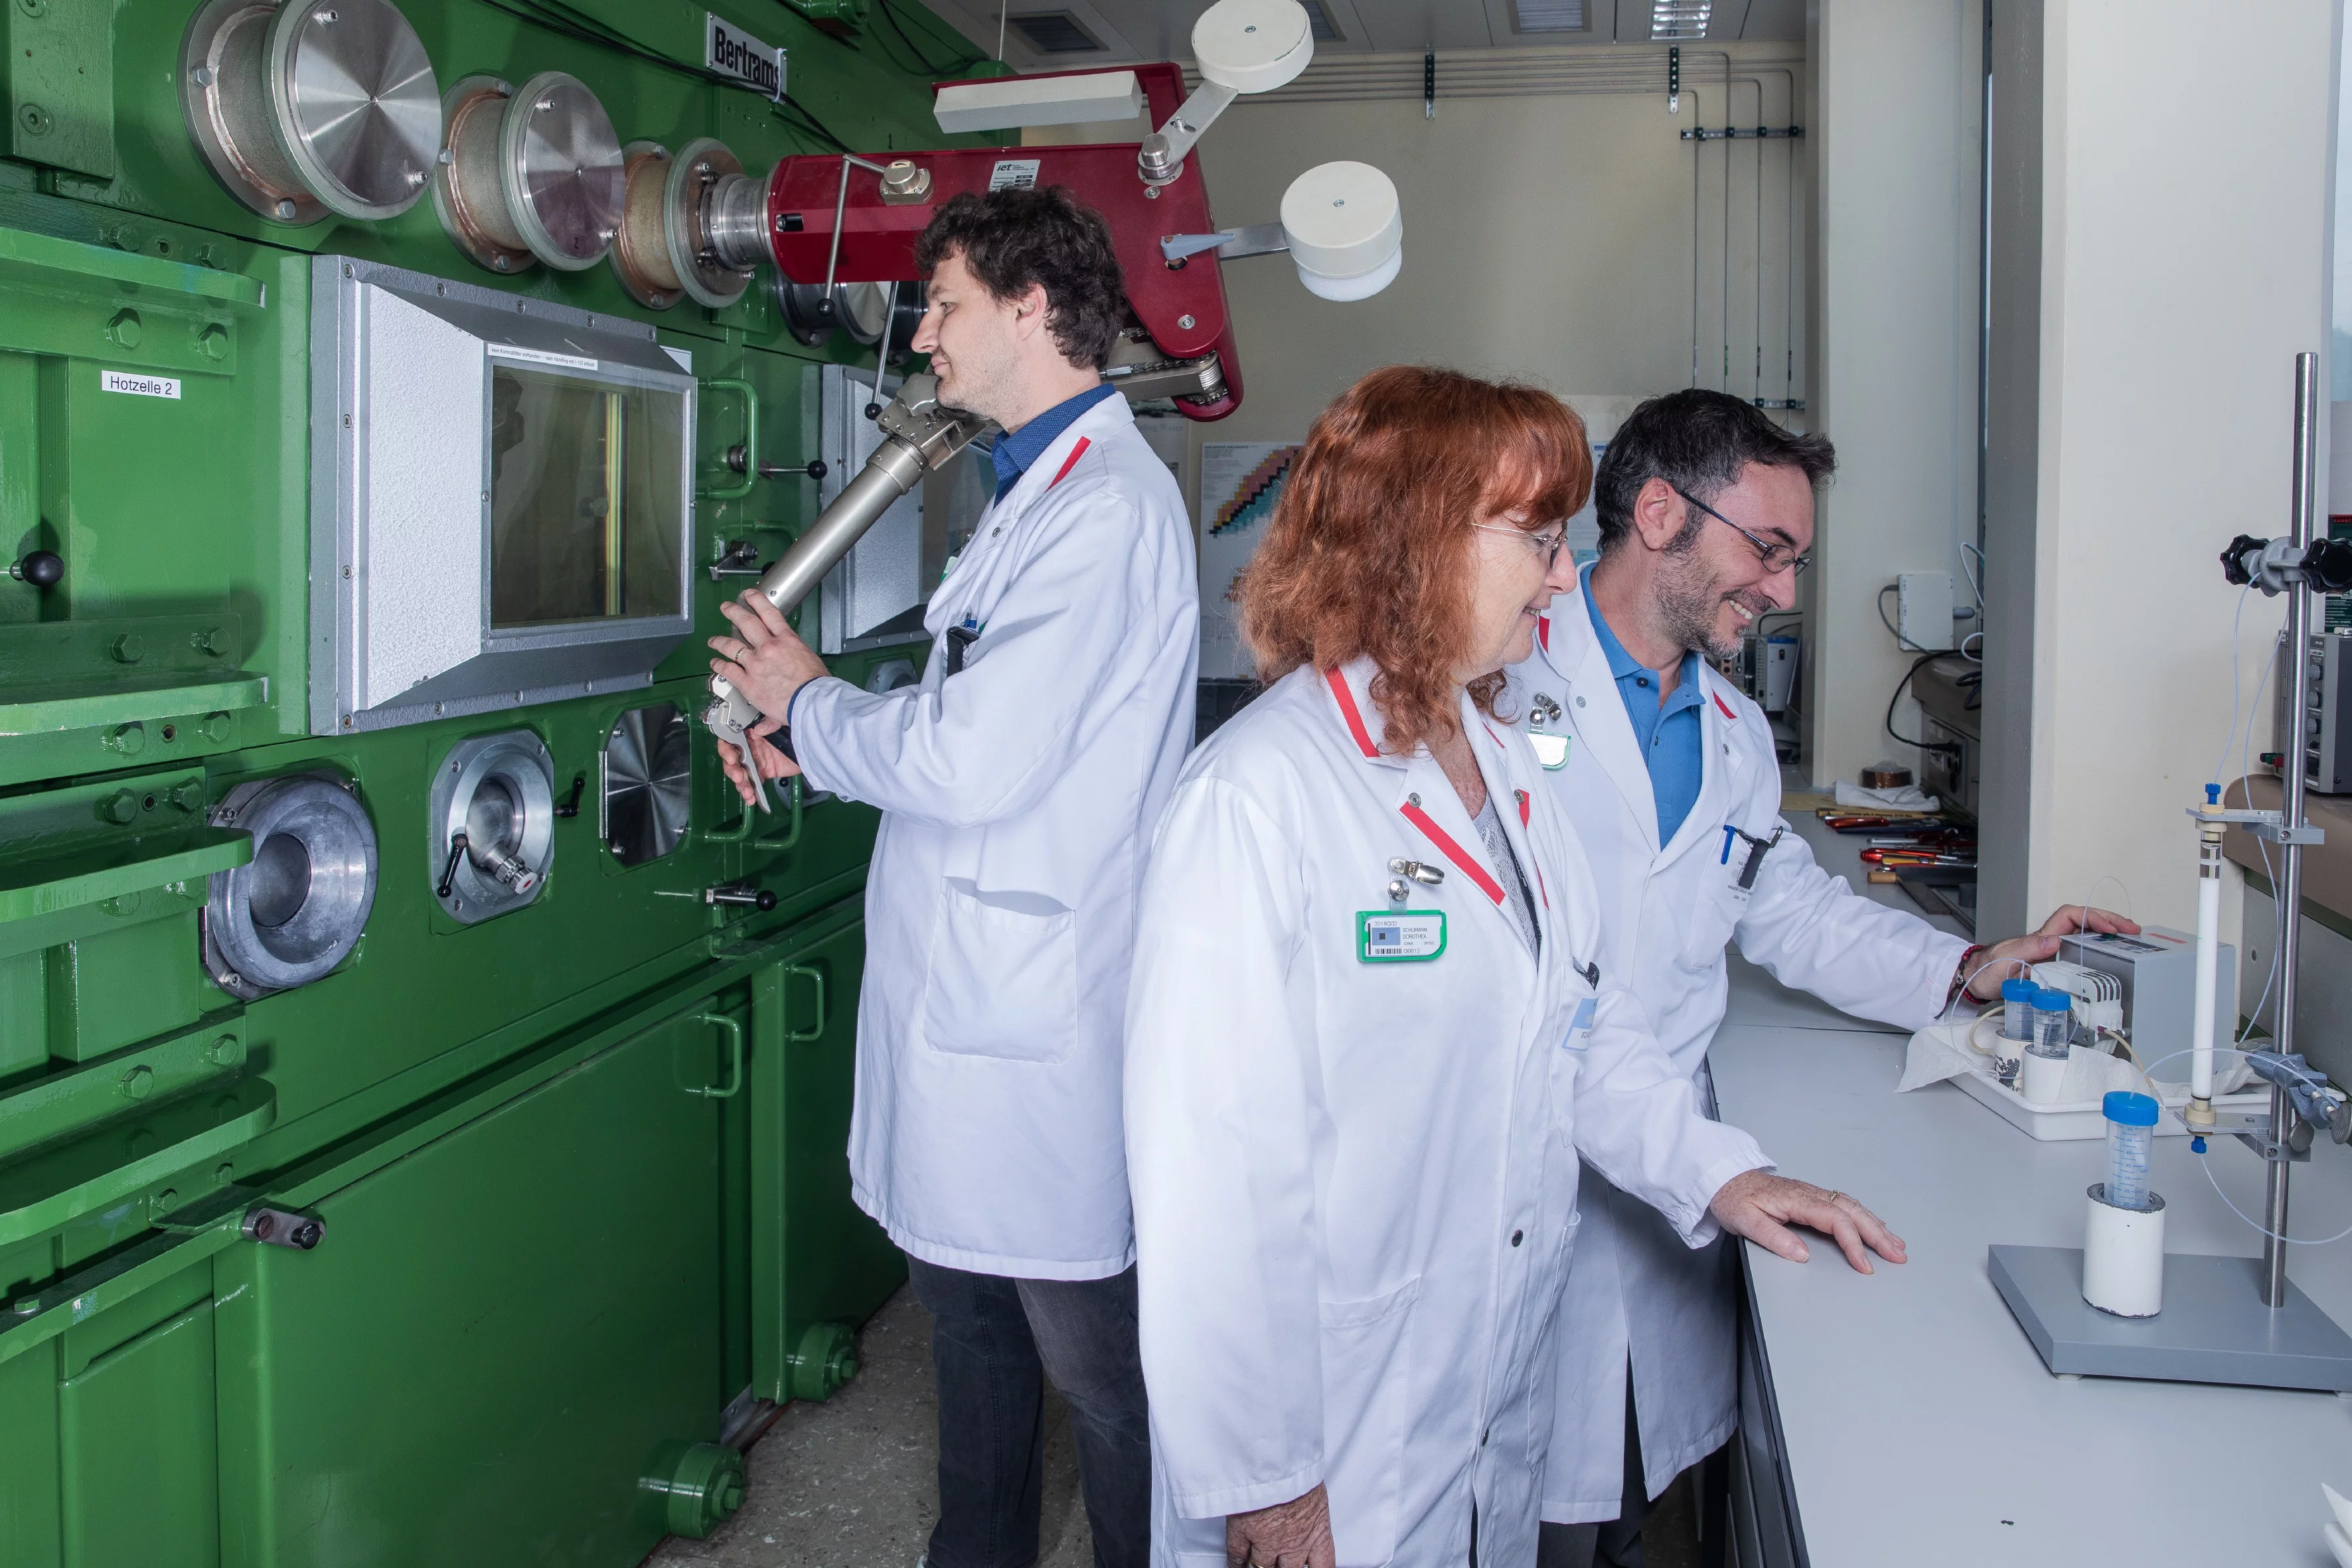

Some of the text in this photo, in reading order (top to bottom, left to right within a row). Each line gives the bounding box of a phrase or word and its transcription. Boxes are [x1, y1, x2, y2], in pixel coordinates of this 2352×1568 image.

[715, 26, 781, 89] Bertrams
[111, 376, 172, 395] Hotzelle 2
